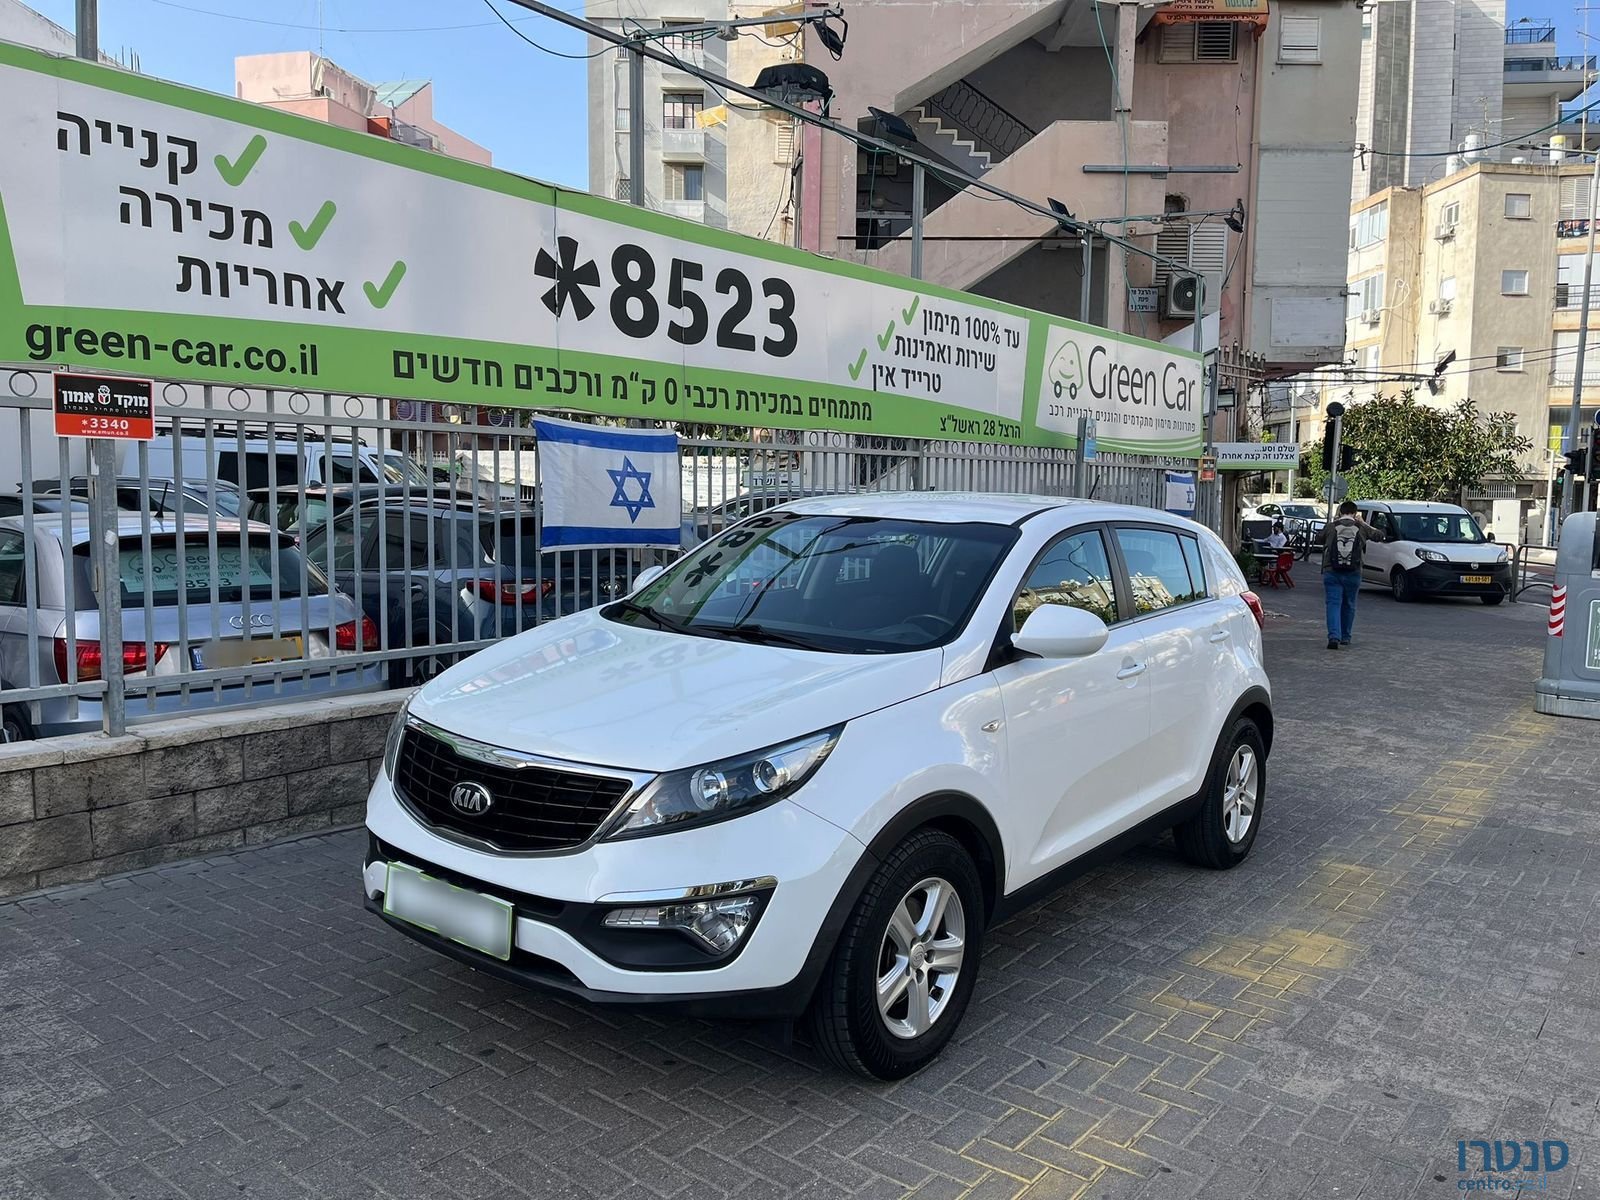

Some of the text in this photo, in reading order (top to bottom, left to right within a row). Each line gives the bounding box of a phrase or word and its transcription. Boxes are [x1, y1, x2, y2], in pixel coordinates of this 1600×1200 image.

[56, 111, 198, 185] קנייה
[119, 185, 273, 249] מכירה
[176, 255, 346, 314] אחריות
[922, 308, 1021, 349] עד 100% מימון
[25, 323, 319, 376] green-car.co.il
[894, 334, 996, 373] שירות ואמינות
[392, 350, 873, 422] מתמחים במכירת רכבי 0 ק"מ ורכבים חדשים
[871, 363, 942, 394] טרייד אין
[1087, 345, 1196, 413] Green Car
[61, 389, 149, 409] מוקד אמון
[1048, 404, 1064, 417] רכב
[939, 414, 1021, 440] הרצל 28 ראשל"צ
[1095, 410, 1121, 424] והוגנים
[1123, 413, 1154, 430] מתקדמים
[1155, 417, 1172, 431] מימון
[1172, 419, 1196, 433] פתרונות
[1244, 453, 1261, 461] קצת
[1272, 452, 1295, 460] אצלנו
[1277, 444, 1296, 453] שלם
[454, 786, 481, 811] KIA
